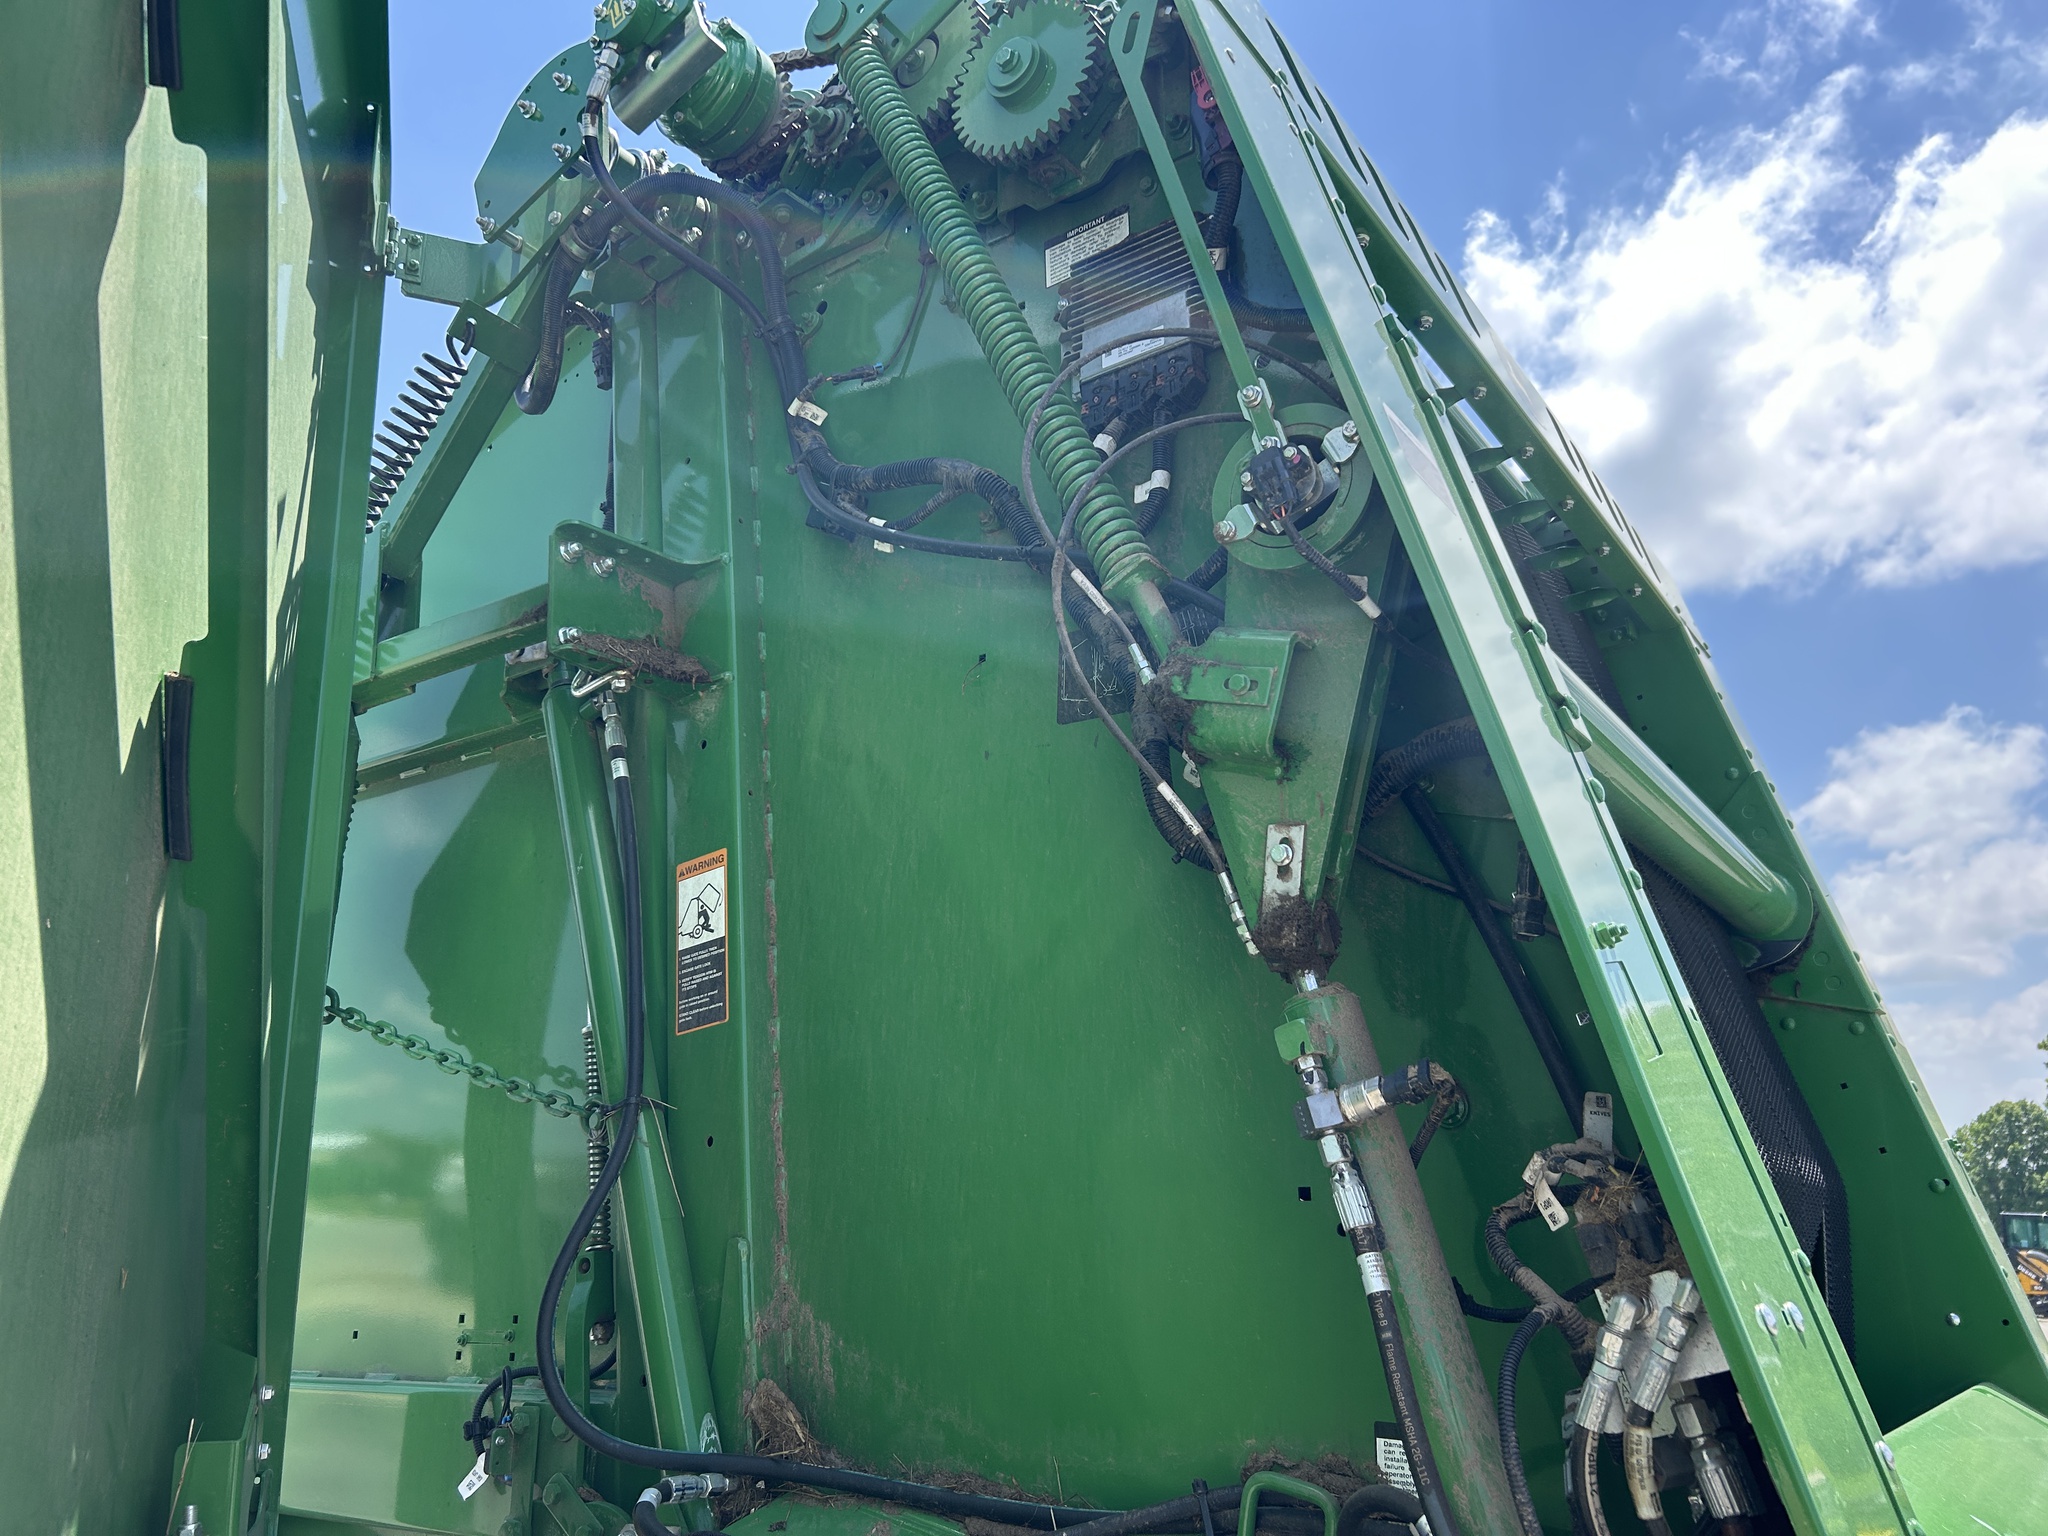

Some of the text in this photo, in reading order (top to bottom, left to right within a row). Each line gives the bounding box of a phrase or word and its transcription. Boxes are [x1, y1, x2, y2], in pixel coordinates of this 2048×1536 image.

[1066, 215, 1105, 238] IMPORTANT
[685, 854, 724, 875] WARNING
[1374, 1300, 1384, 1318] Type
[1385, 1343, 1396, 1371] Flame
[1392, 1372, 1409, 1416] Resistant
[1403, 1418, 1418, 1446] MSHA
